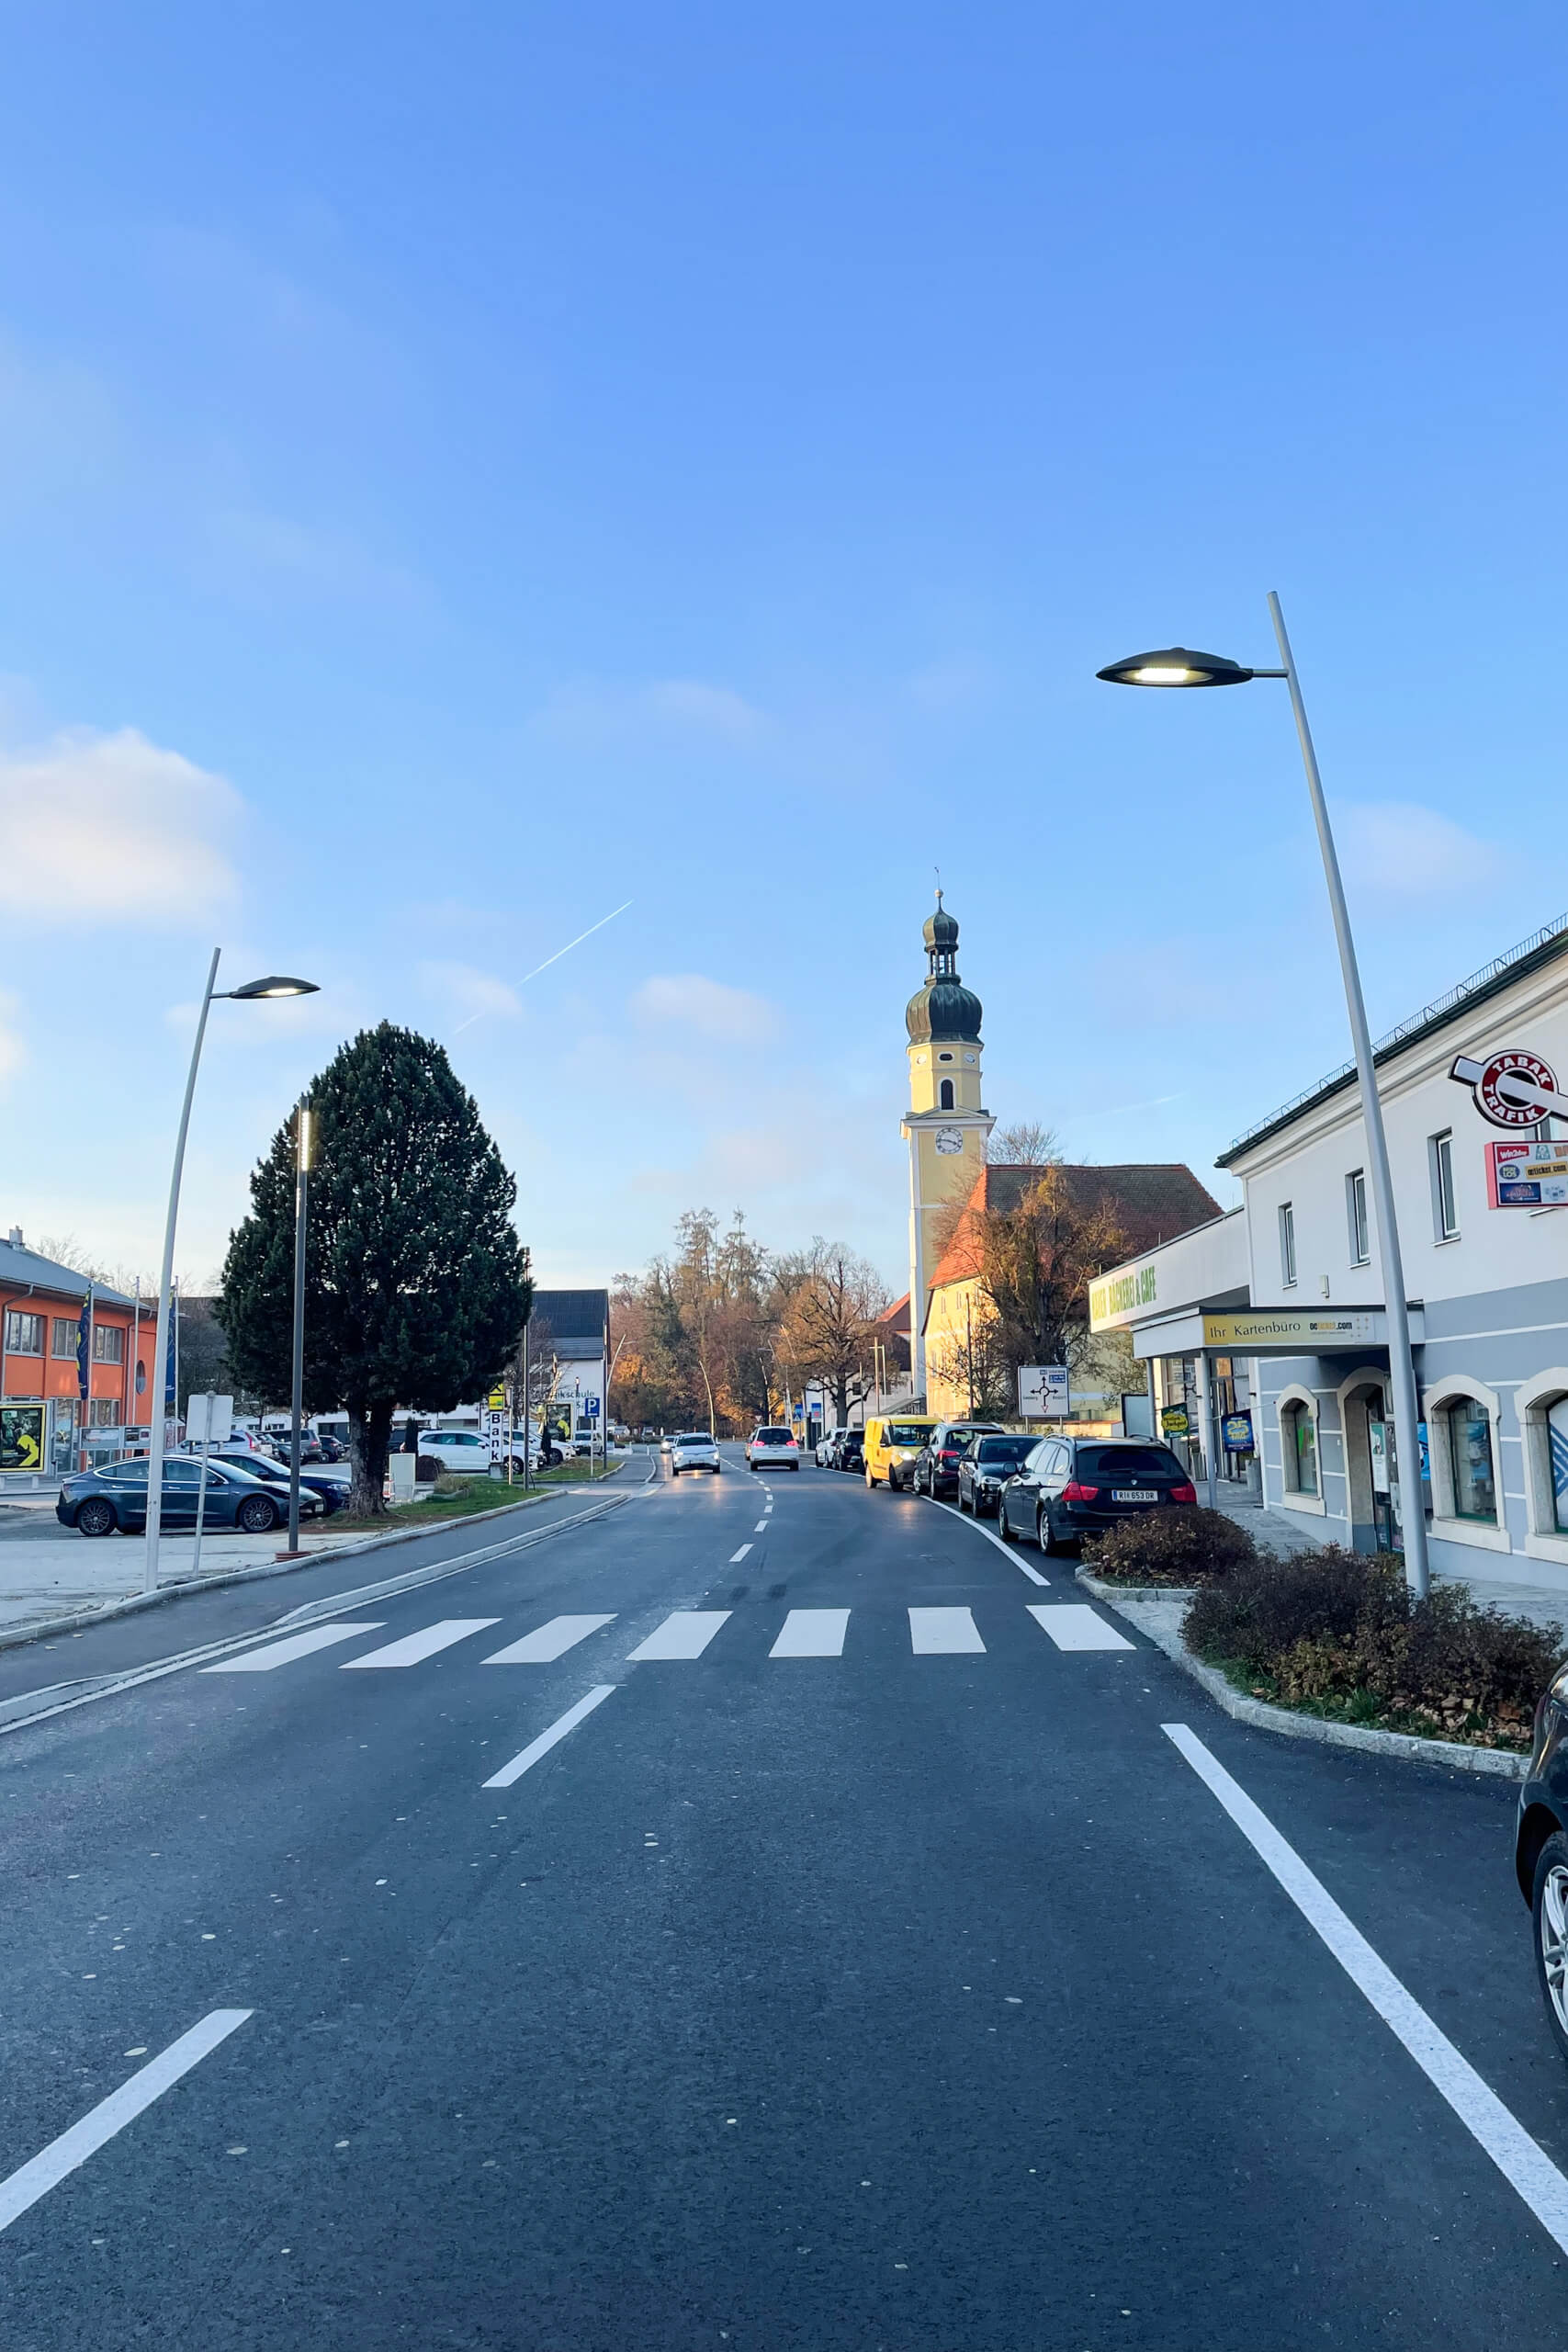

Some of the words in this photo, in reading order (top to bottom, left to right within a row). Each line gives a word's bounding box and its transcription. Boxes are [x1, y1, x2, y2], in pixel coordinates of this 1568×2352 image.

[1492, 1056, 1551, 1084] TABAK
[1483, 1083, 1540, 1123] TRAFIK
[1210, 1327, 1227, 1339] Ihr
[1234, 1321, 1302, 1337] Kartenbüro
[588, 1399, 597, 1412] P
[1226, 1419, 1249, 1436] 25
[491, 1414, 501, 1461] Bank
[1119, 1491, 1126, 1499] RI
[1131, 1491, 1145, 1499] 653
